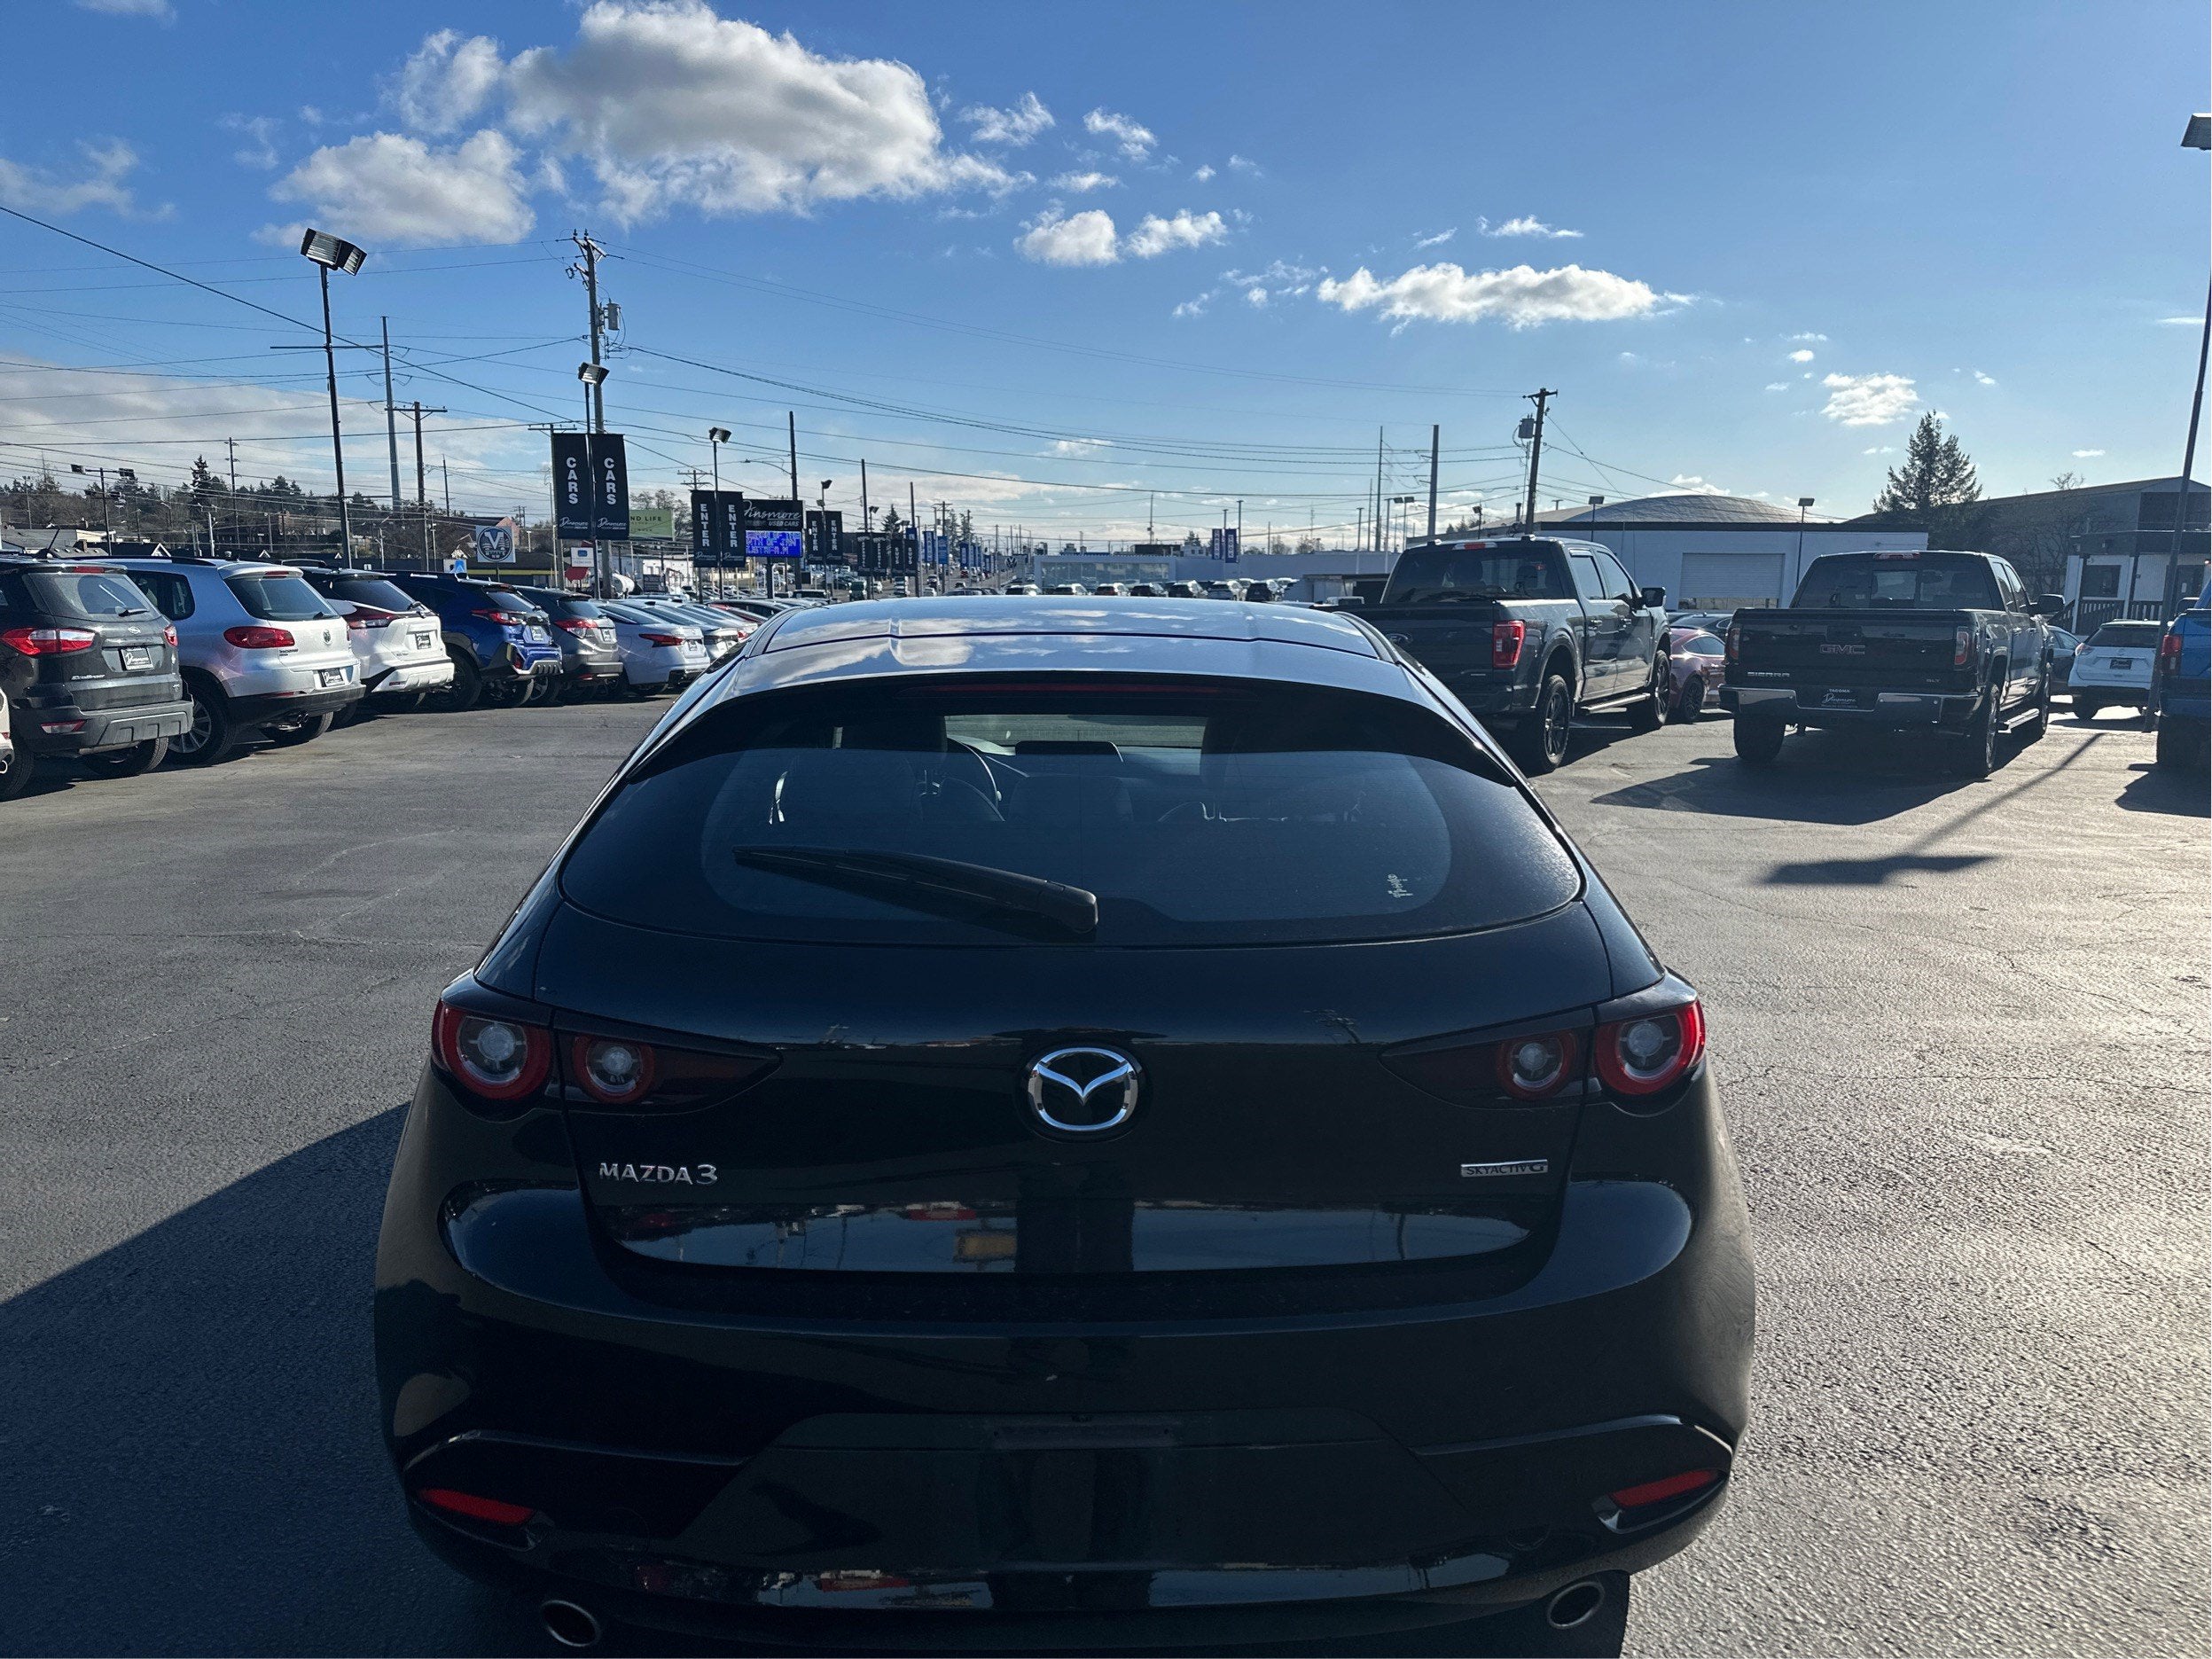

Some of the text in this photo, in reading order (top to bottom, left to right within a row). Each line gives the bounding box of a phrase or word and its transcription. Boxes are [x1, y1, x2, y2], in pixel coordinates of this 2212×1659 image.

[566, 457, 579, 505] CARS
[604, 457, 617, 505] CARS
[700, 503, 710, 547] ENTER
[728, 504, 738, 548] ENTER
[1820, 644, 1865, 655] GMC
